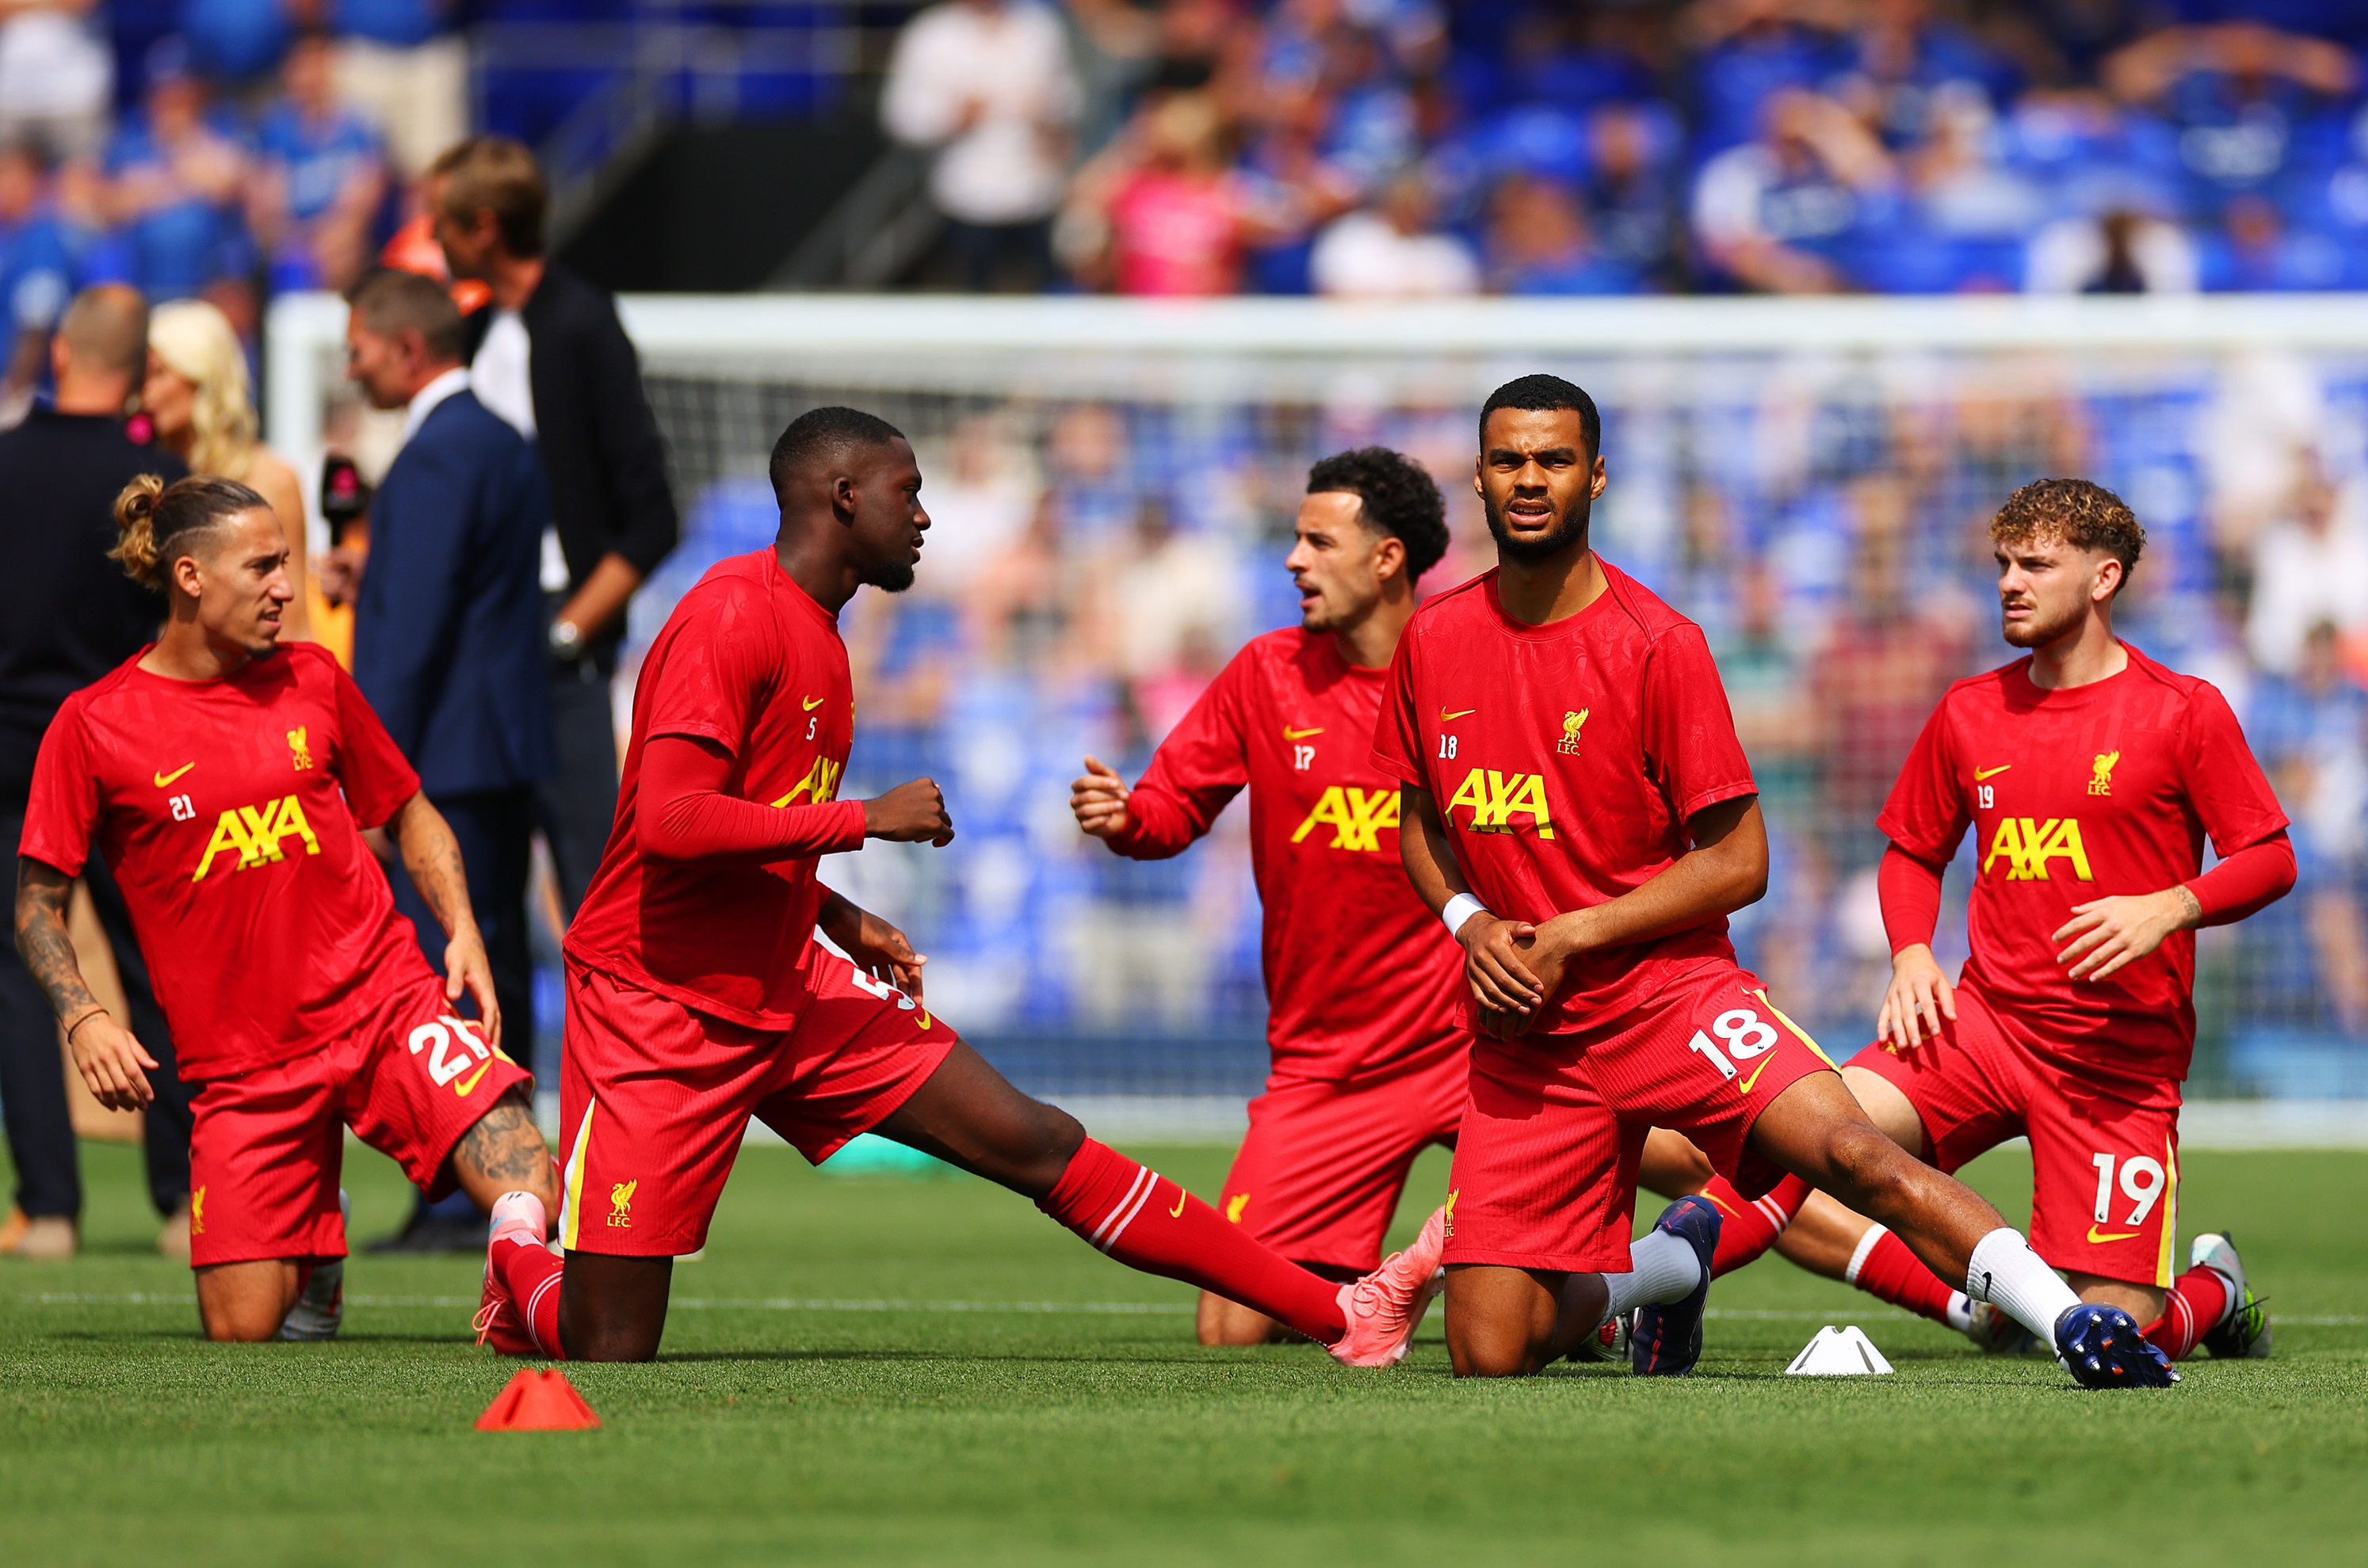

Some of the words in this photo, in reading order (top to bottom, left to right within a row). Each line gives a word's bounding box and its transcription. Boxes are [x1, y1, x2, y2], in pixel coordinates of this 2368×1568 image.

[806, 717, 817, 741] 5
[1438, 734, 1458, 760] 18
[770, 754, 840, 809] AXA
[1294, 745, 1316, 771] 17
[169, 794, 196, 822] 21
[1445, 768, 1556, 840] AXA
[1977, 784, 1995, 809] 19
[192, 795, 321, 883] AXA
[1984, 817, 2095, 882] AXA
[852, 967, 916, 1010] 5
[408, 1015, 491, 1088] 21
[1688, 1009, 1778, 1081] 18
[2092, 1152, 2165, 1226] 19
